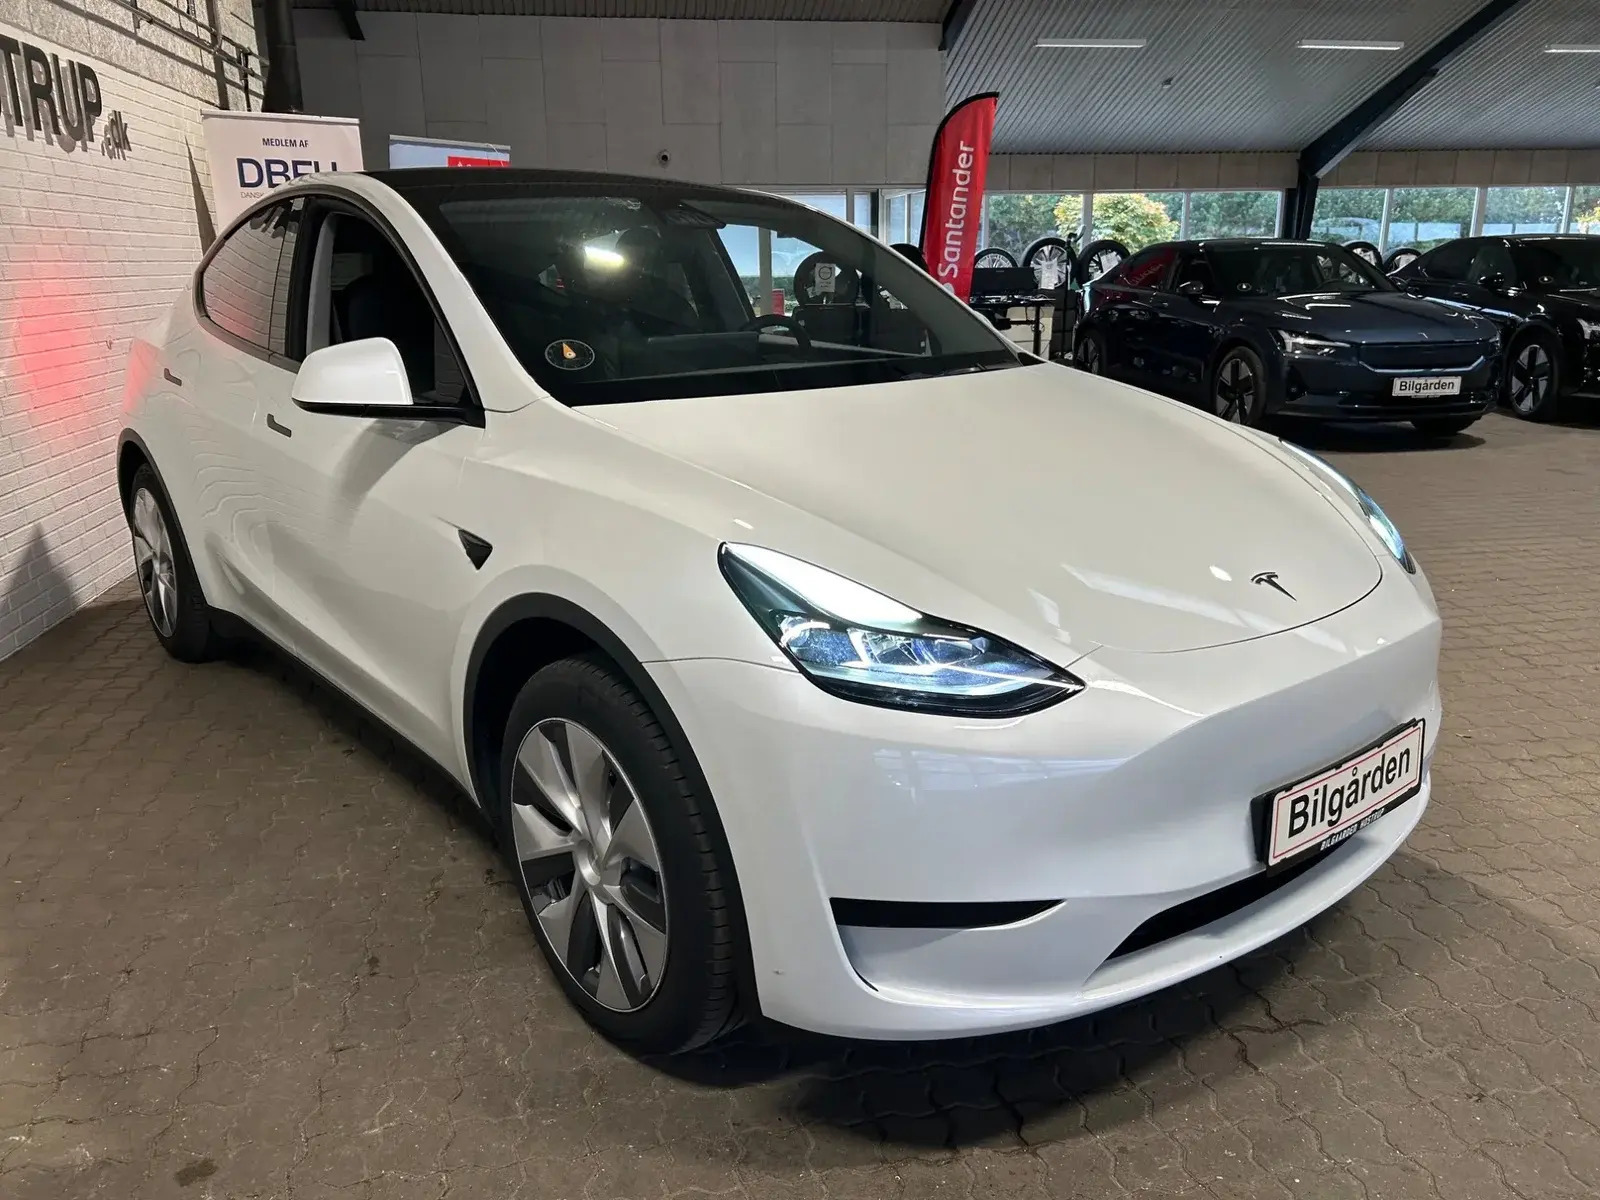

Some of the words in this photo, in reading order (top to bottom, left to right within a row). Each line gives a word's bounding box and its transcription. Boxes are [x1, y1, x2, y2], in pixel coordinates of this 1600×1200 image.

[0, 34, 132, 152] TRUP.dk
[262, 138, 297, 148] MEDLEM
[299, 140, 309, 148] AF
[937, 140, 975, 278] Santander
[1399, 379, 1455, 393] Bilgården
[1288, 747, 1410, 838] Bilgården
